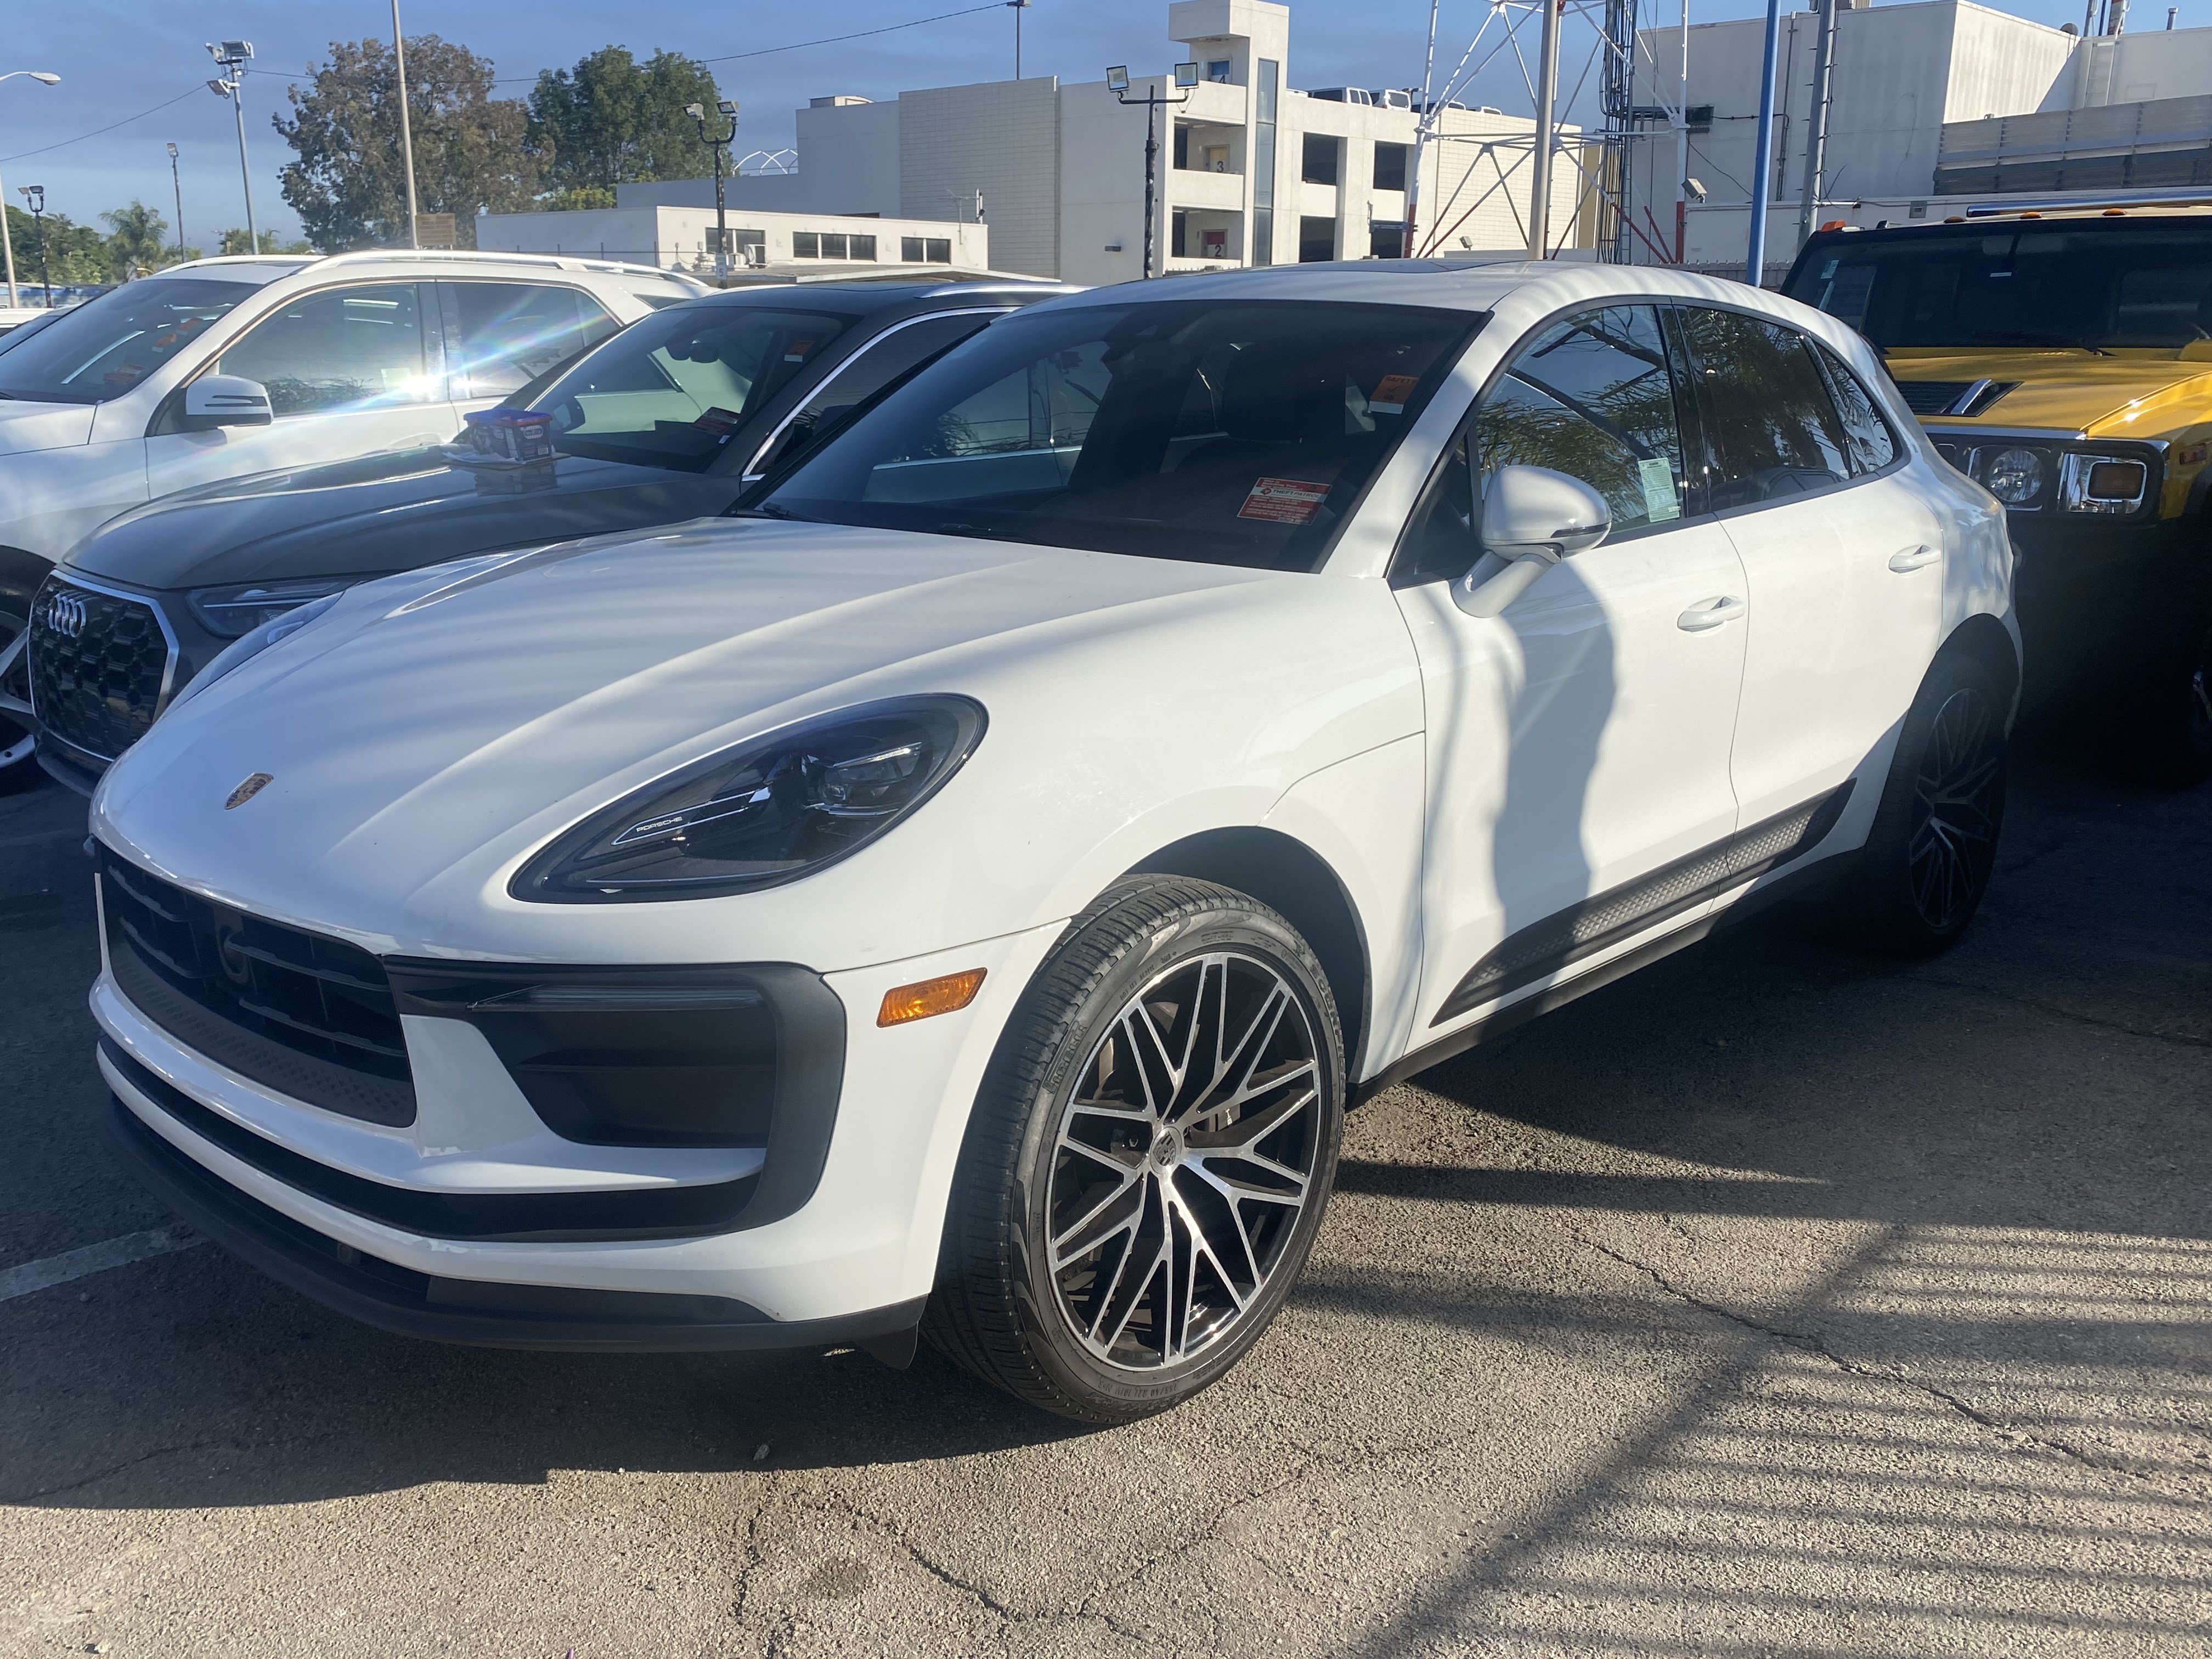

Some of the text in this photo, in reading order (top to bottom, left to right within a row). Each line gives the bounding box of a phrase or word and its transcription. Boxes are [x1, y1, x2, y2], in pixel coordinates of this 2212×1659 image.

[1218, 75, 1226, 83] 4
[1217, 161, 1224, 172] 3
[1215, 244, 1221, 257] 2
[719, 268, 724, 276] 5
[636, 816, 683, 832] PORSCHE
